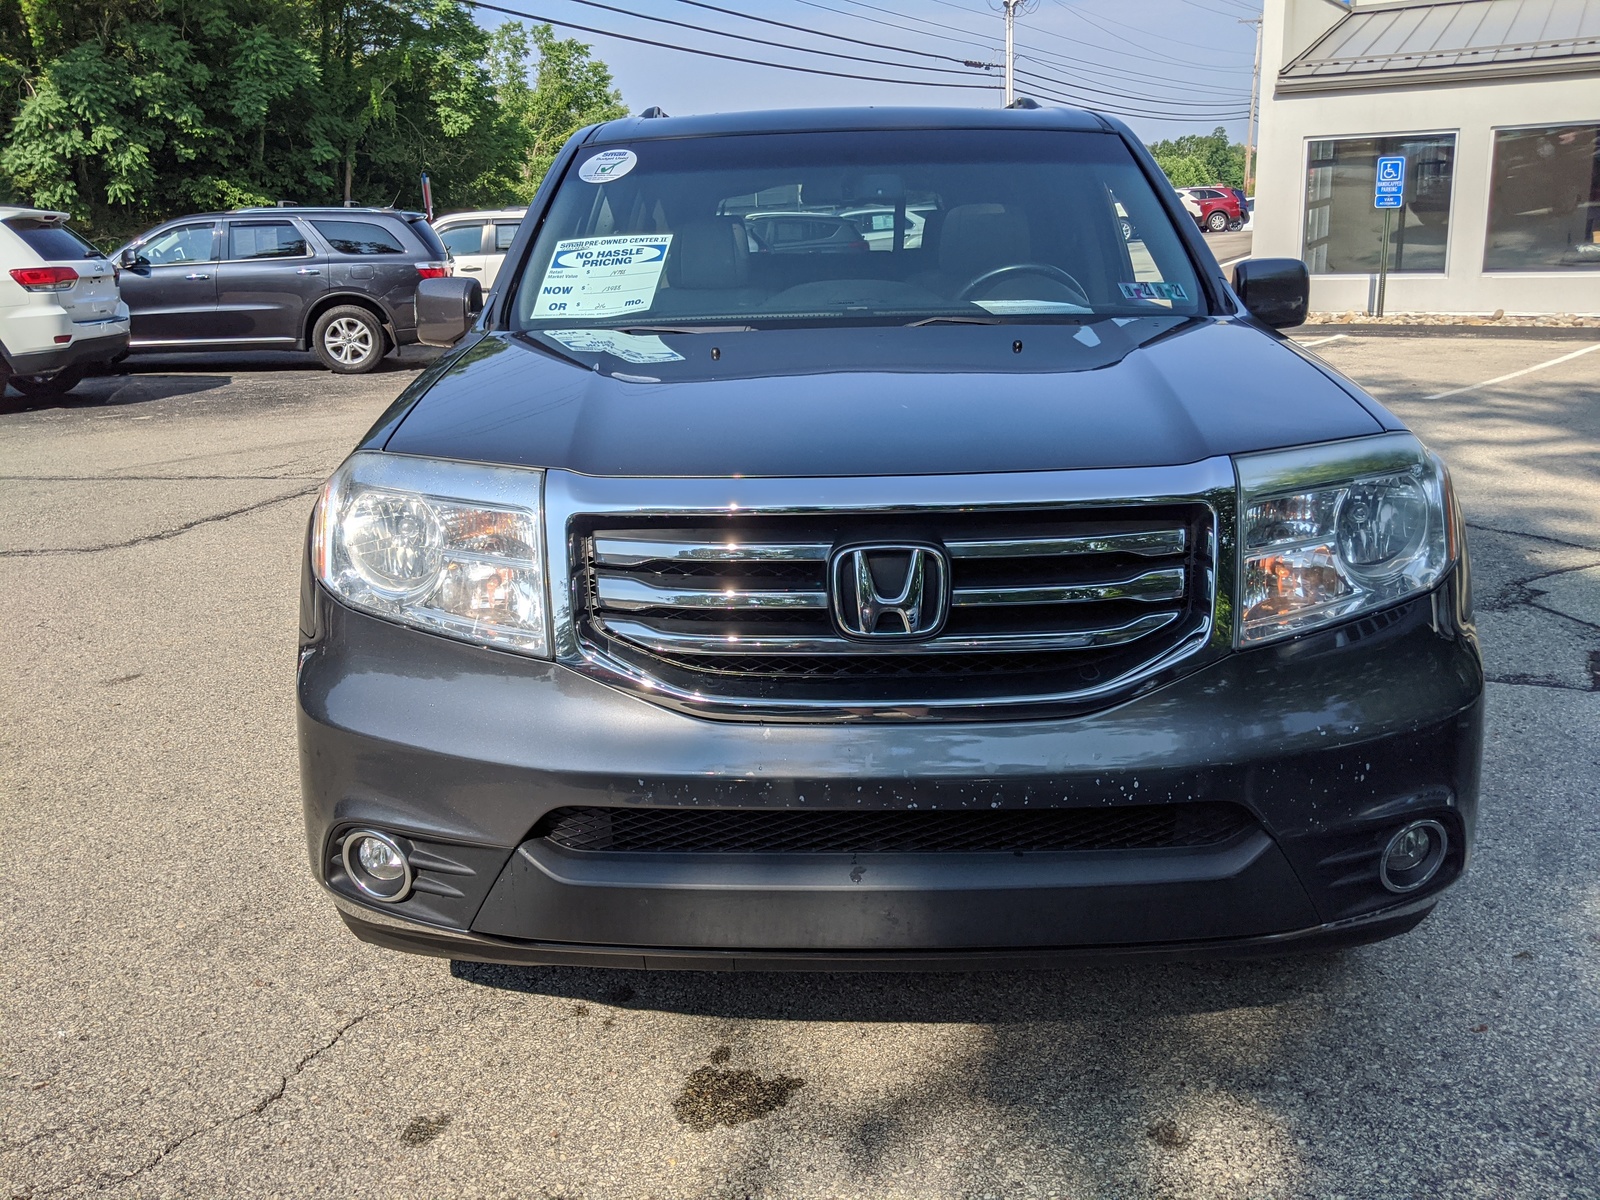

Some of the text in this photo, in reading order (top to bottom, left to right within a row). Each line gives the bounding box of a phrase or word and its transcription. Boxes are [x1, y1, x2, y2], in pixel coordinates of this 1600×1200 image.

[585, 238, 628, 247] PRE-OWNED
[575, 251, 593, 260] NO
[596, 248, 644, 258] HASSLE
[582, 257, 632, 268] PRICING
[542, 286, 573, 295] NOW
[1140, 283, 1154, 296] 21
[1171, 284, 1185, 298] 21
[548, 302, 568, 311] OR
[624, 299, 645, 307] mo.
